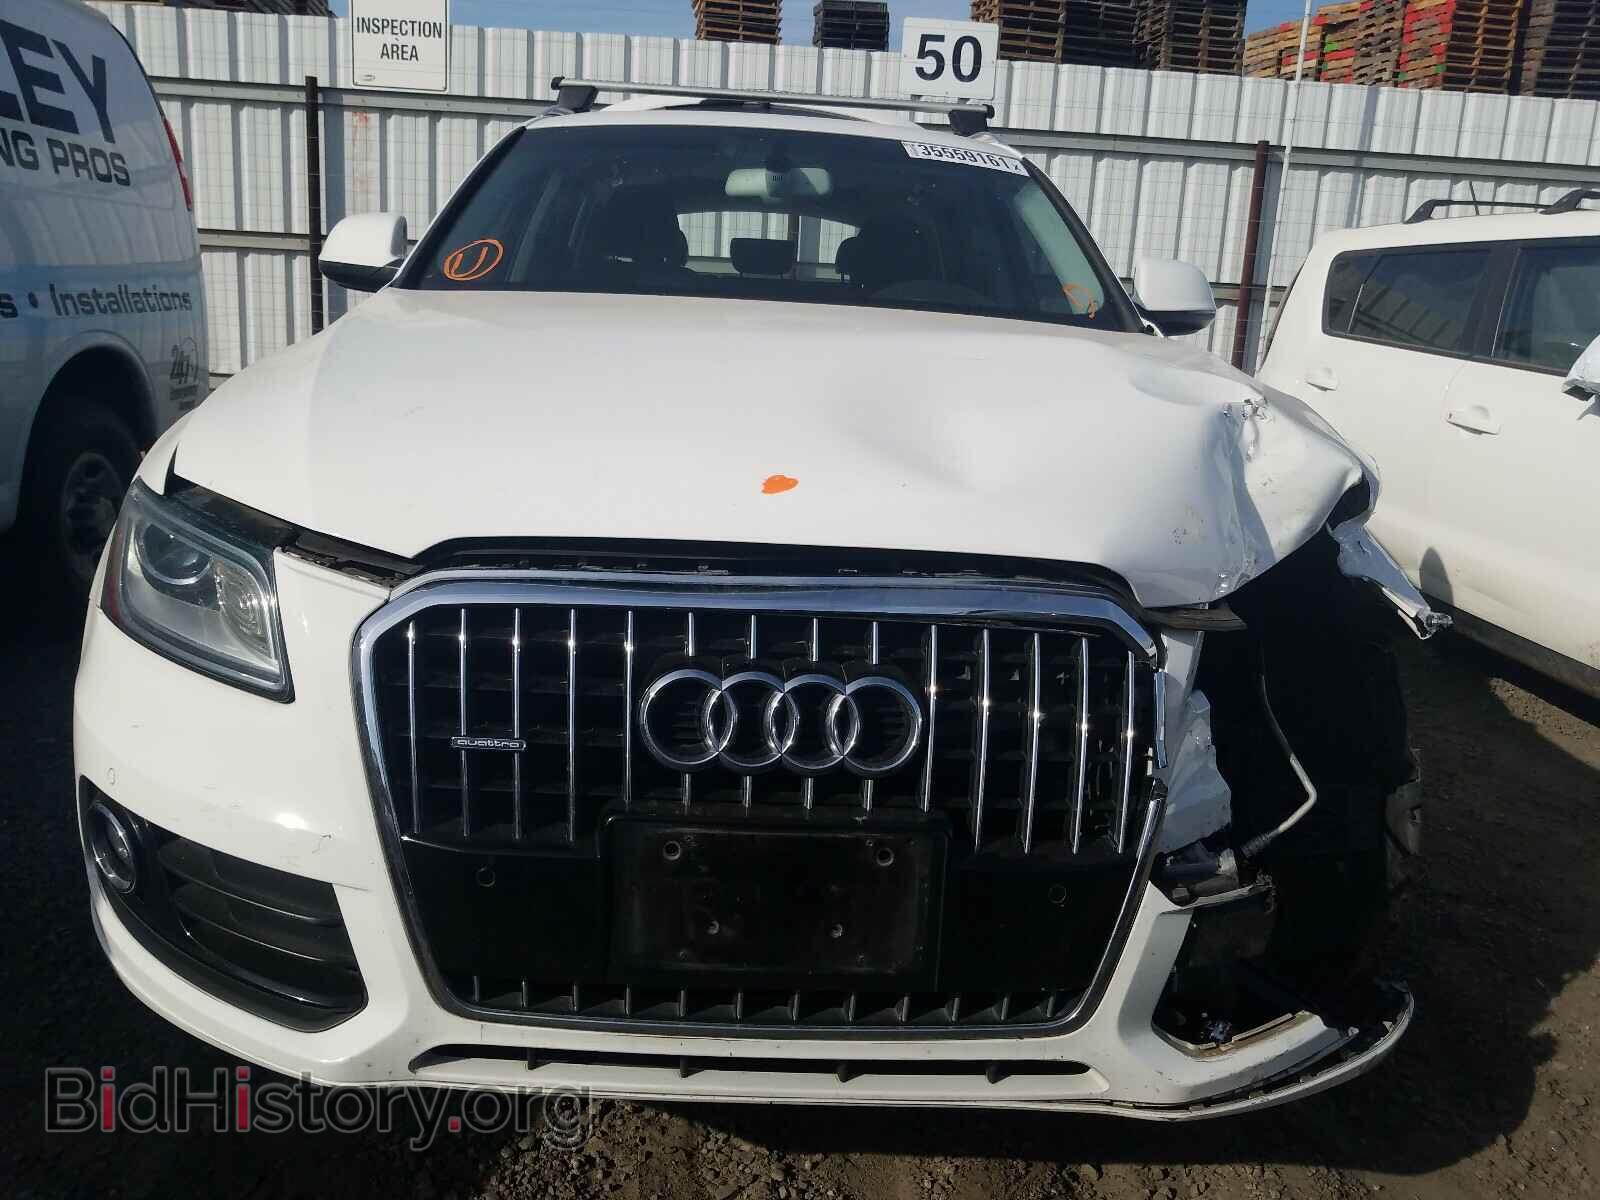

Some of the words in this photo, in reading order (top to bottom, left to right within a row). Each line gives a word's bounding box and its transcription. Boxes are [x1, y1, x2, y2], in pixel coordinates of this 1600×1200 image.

[356, 16, 442, 39] INSPECTION
[380, 43, 419, 61] AREA
[915, 33, 982, 83] 50
[47, 137, 131, 187] PROS
[918, 143, 1011, 169] 35559161
[50, 283, 193, 316] Installations
[457, 739, 520, 748] quattro
